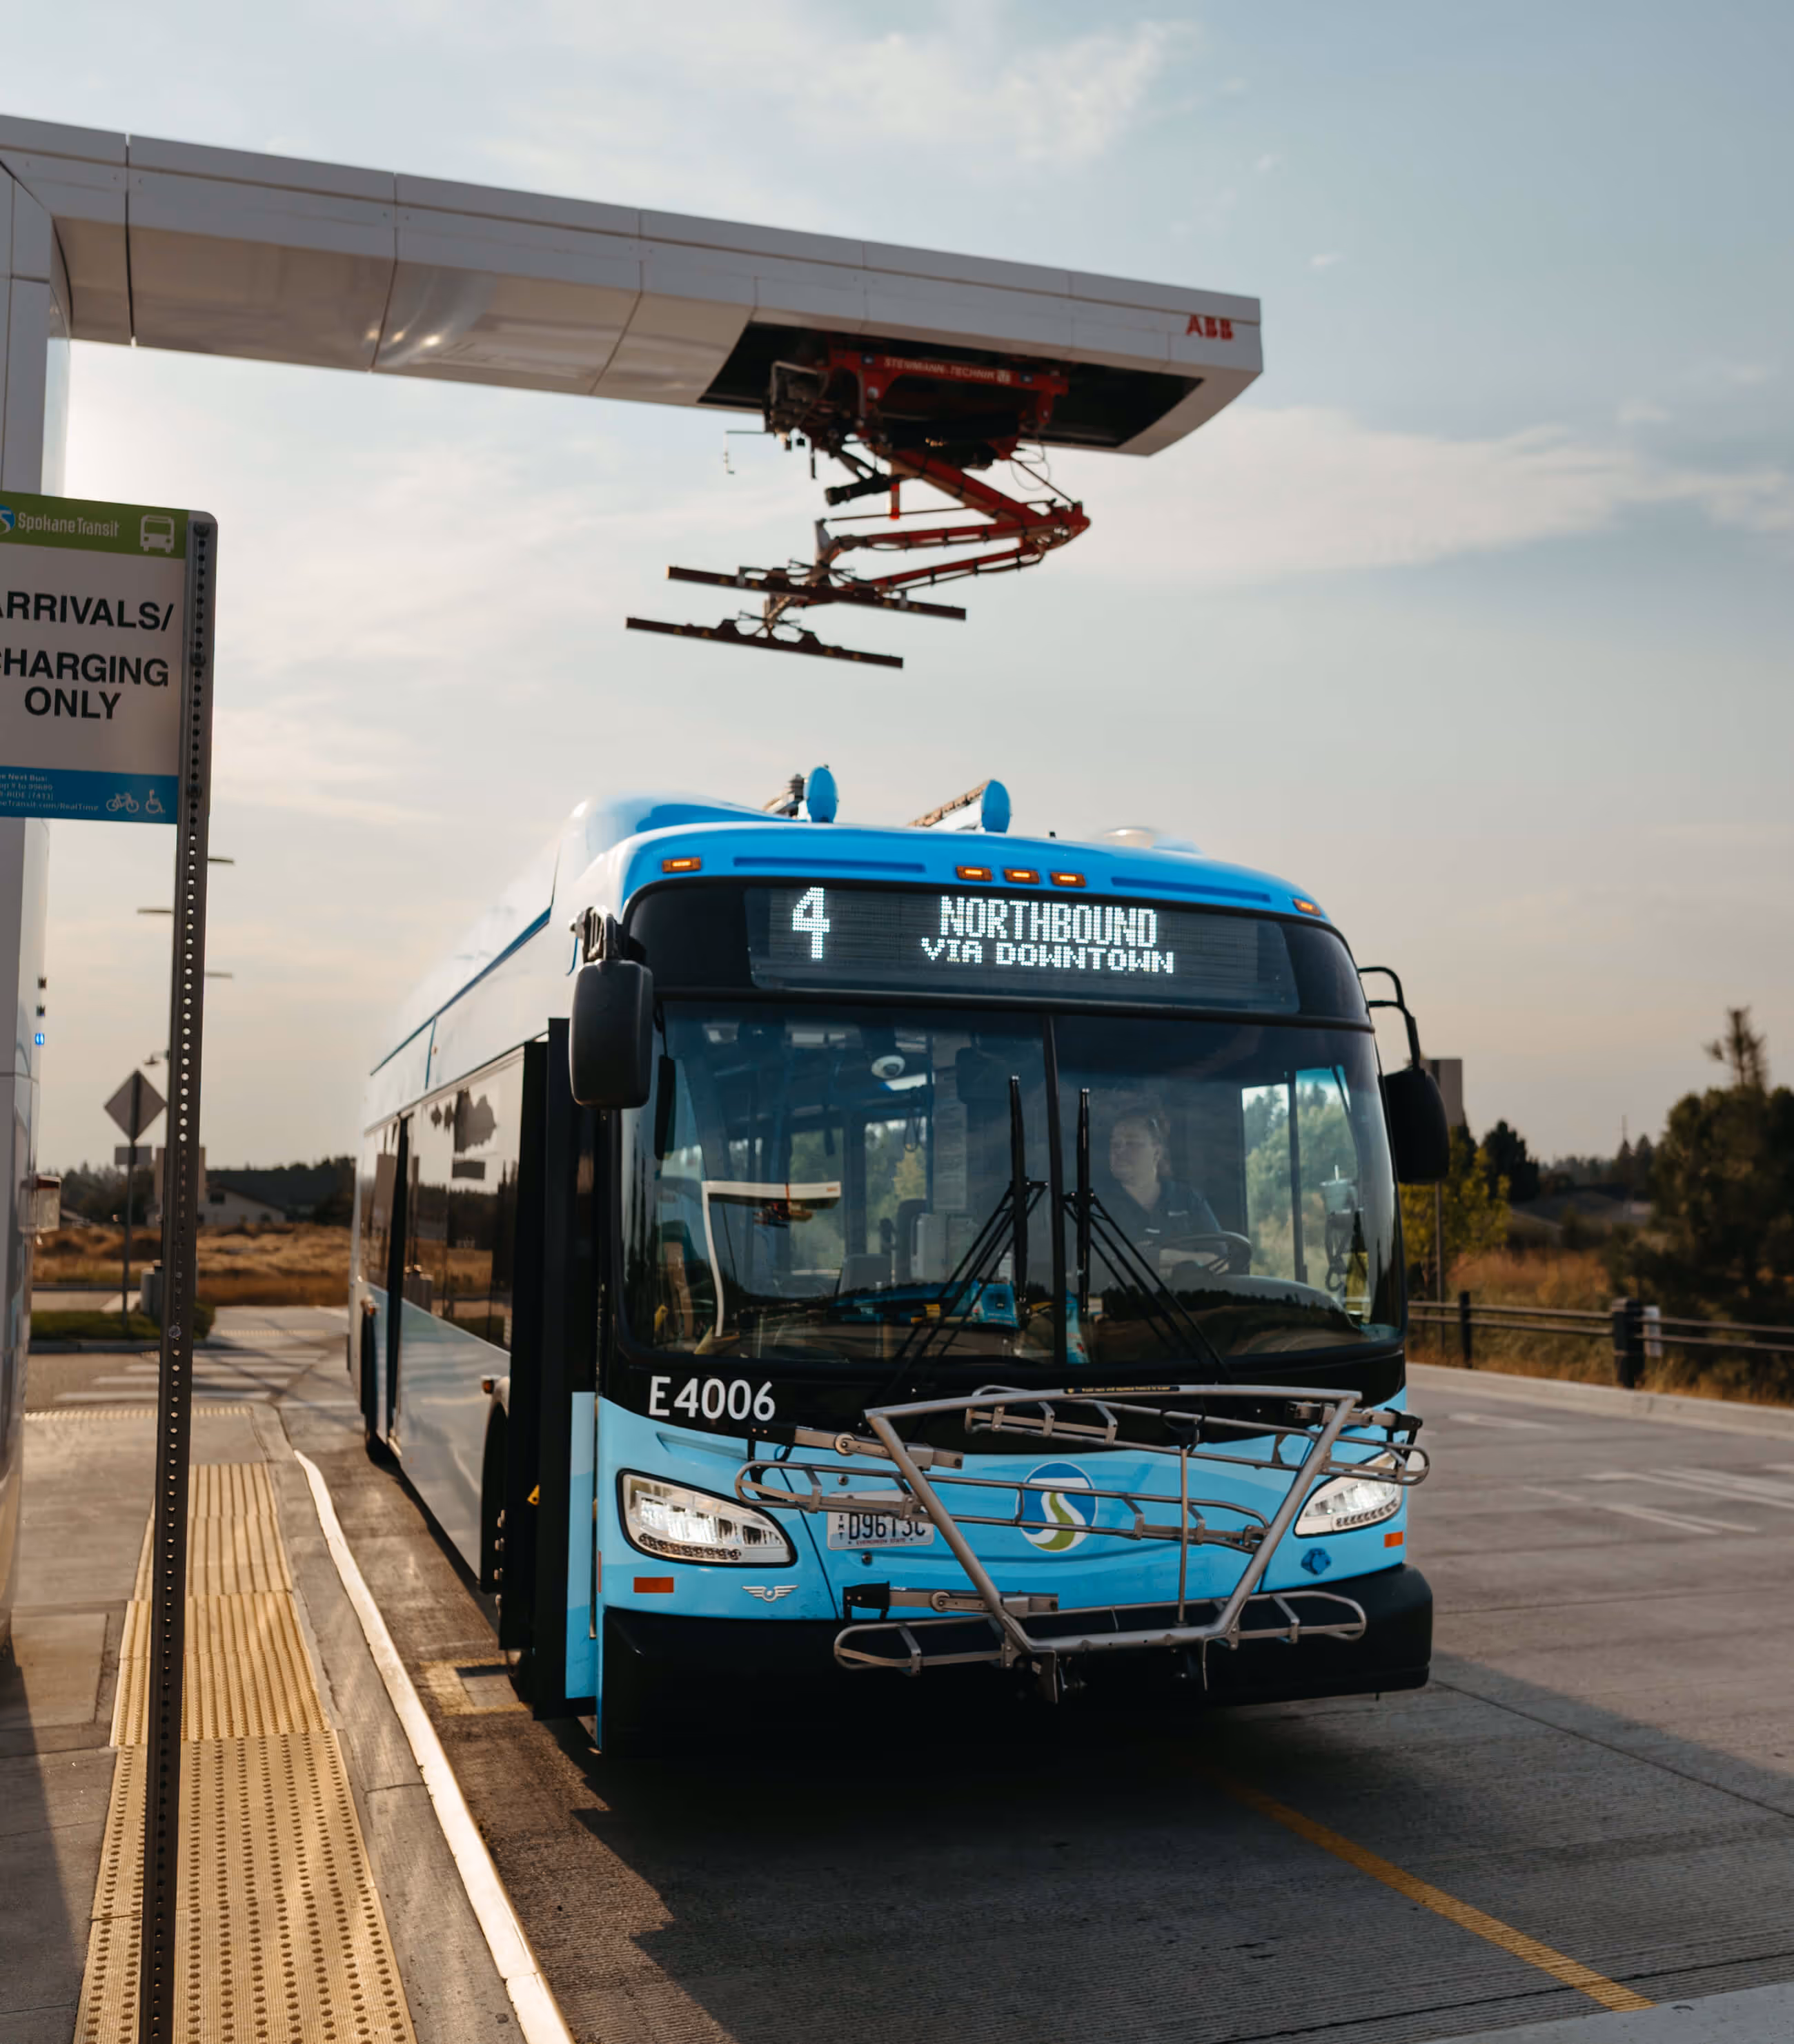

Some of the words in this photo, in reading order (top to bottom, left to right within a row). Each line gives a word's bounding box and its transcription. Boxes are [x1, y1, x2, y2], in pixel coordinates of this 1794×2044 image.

[1185, 315, 1234, 340] ABB
[19, 512, 75, 533] Spokane
[77, 518, 119, 538] Transit
[0, 647, 169, 687] HARGING
[25, 686, 121, 720] ONLY
[792, 887, 830, 961] 4
[940, 896, 1157, 948] NORTHBOUND
[921, 938, 983, 964] VIA
[996, 942, 1174, 974] DOWNTOWN
